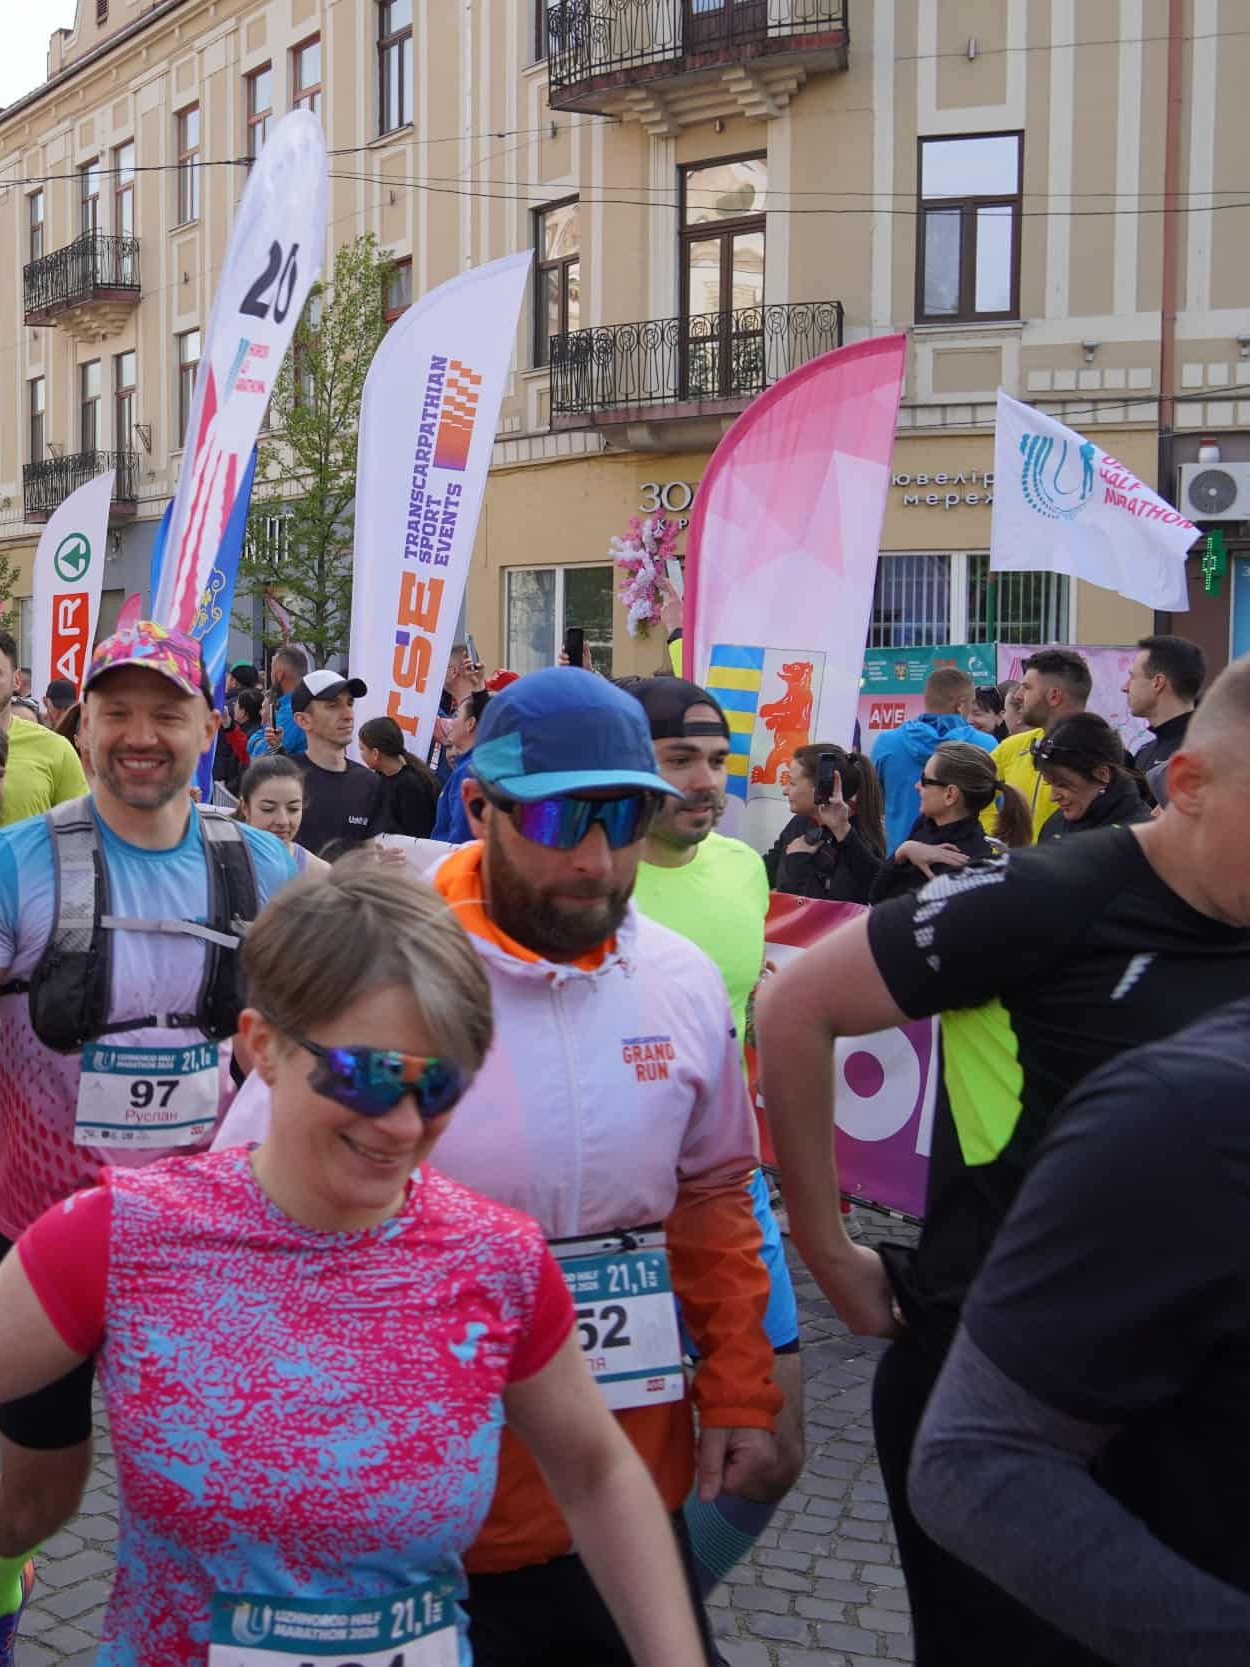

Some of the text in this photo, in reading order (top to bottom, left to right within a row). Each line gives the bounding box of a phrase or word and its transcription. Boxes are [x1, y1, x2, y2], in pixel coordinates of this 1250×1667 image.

[404, 355, 448, 559] TRANSCARPATHIAN
[419, 495, 442, 564] SPORT
[434, 482, 463, 567] EVENTS
[57, 598, 82, 684] AR
[386, 571, 445, 737] TSE
[870, 709, 906, 724] AVE
[622, 1043, 676, 1064] GRAND
[636, 1062, 669, 1082] RUN
[130, 1080, 180, 1108] 97
[607, 1262, 648, 1294] 21,1
[390, 1591, 434, 1639] 21,1
